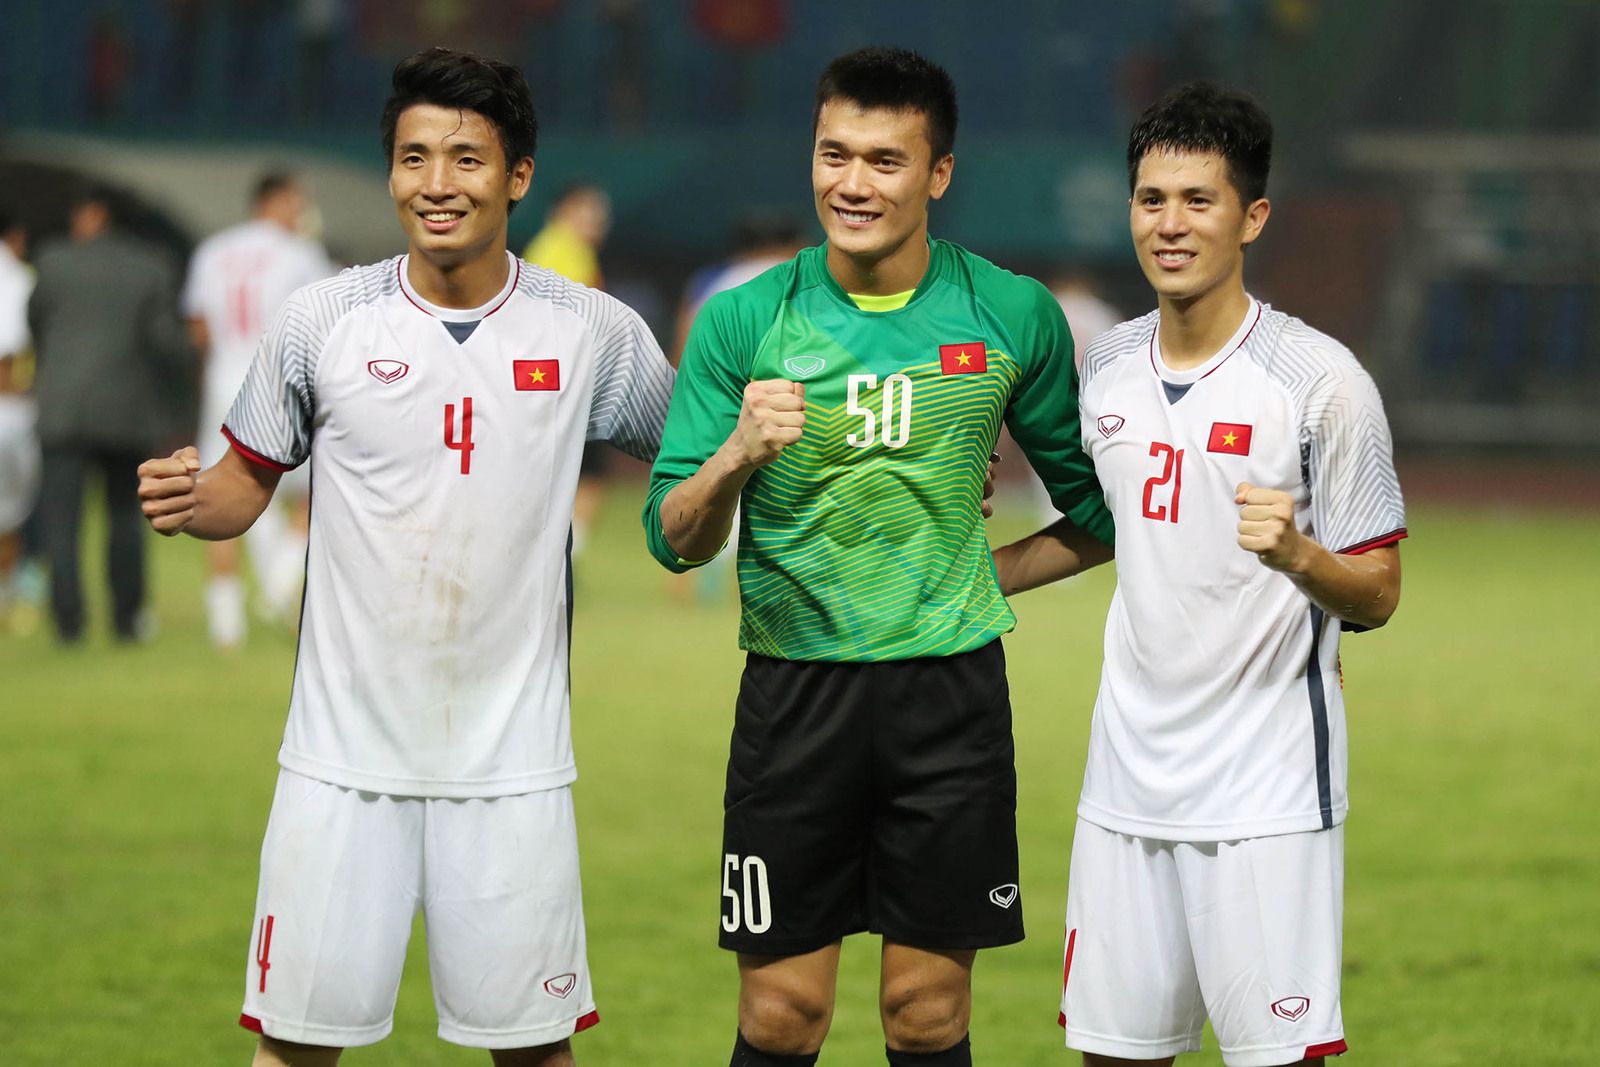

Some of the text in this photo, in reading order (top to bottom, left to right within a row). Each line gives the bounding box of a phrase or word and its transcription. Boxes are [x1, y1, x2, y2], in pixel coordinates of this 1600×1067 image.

[444, 397, 475, 475] 4
[846, 373, 913, 448] 50
[1142, 441, 1185, 524] 21
[722, 853, 772, 934] 50
[257, 915, 274, 993] 4
